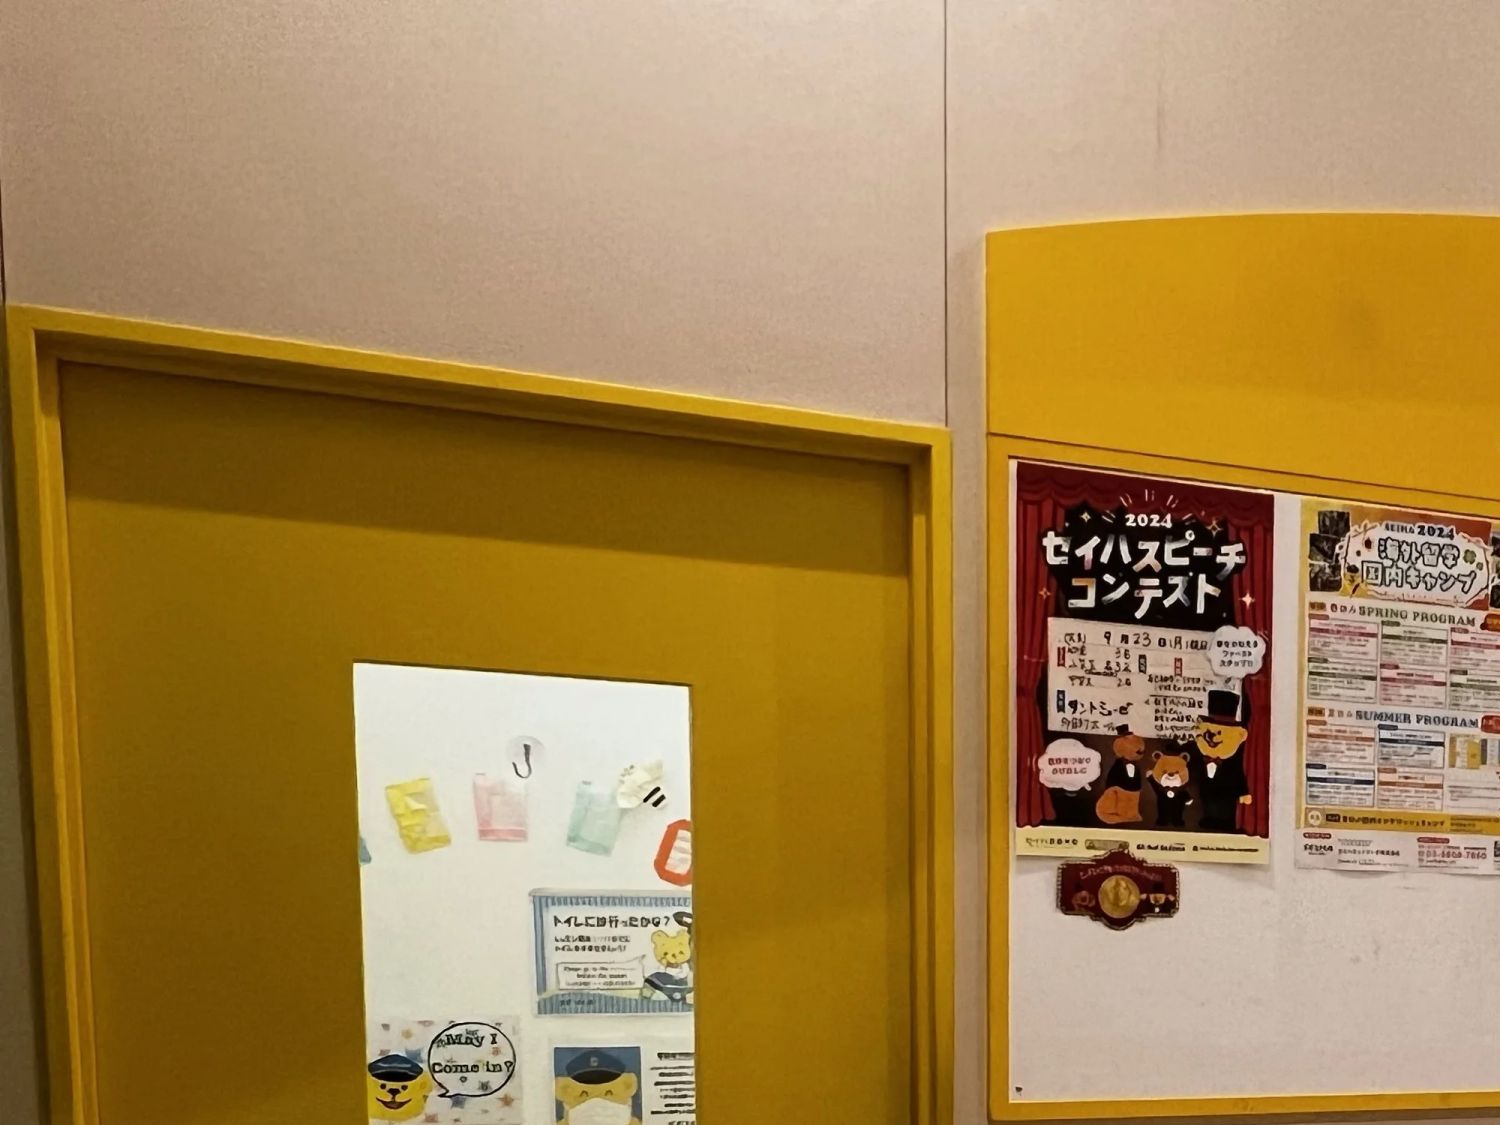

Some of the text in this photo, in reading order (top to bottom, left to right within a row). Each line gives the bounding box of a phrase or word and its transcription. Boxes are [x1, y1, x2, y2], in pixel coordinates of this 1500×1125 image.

[1124, 513, 1173, 529] 2024
[1416, 524, 1456, 540] 2024
[1067, 572, 1222, 620] コンテスト
[445, 1032, 486, 1048] May
[431, 1060, 515, 1075] Come in?
